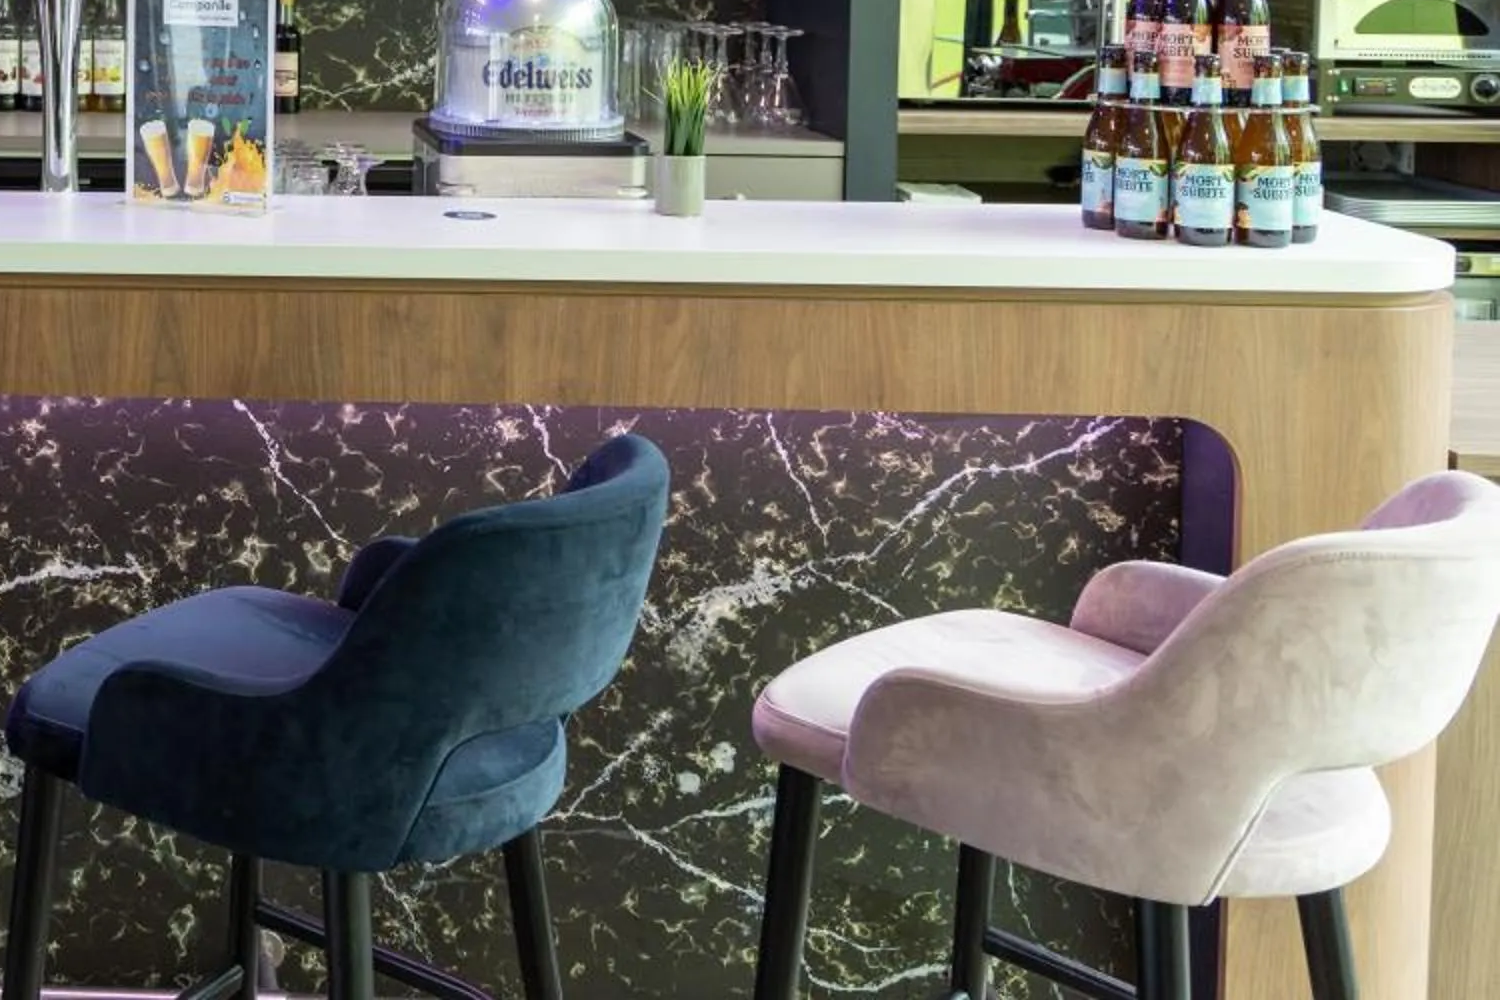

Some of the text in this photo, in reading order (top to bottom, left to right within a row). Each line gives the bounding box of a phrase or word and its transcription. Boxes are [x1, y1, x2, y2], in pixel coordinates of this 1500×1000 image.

[482, 59, 593, 90] Edelweiss
[1185, 174, 1222, 187] MORT
[1181, 185, 1227, 199] SUBITE
